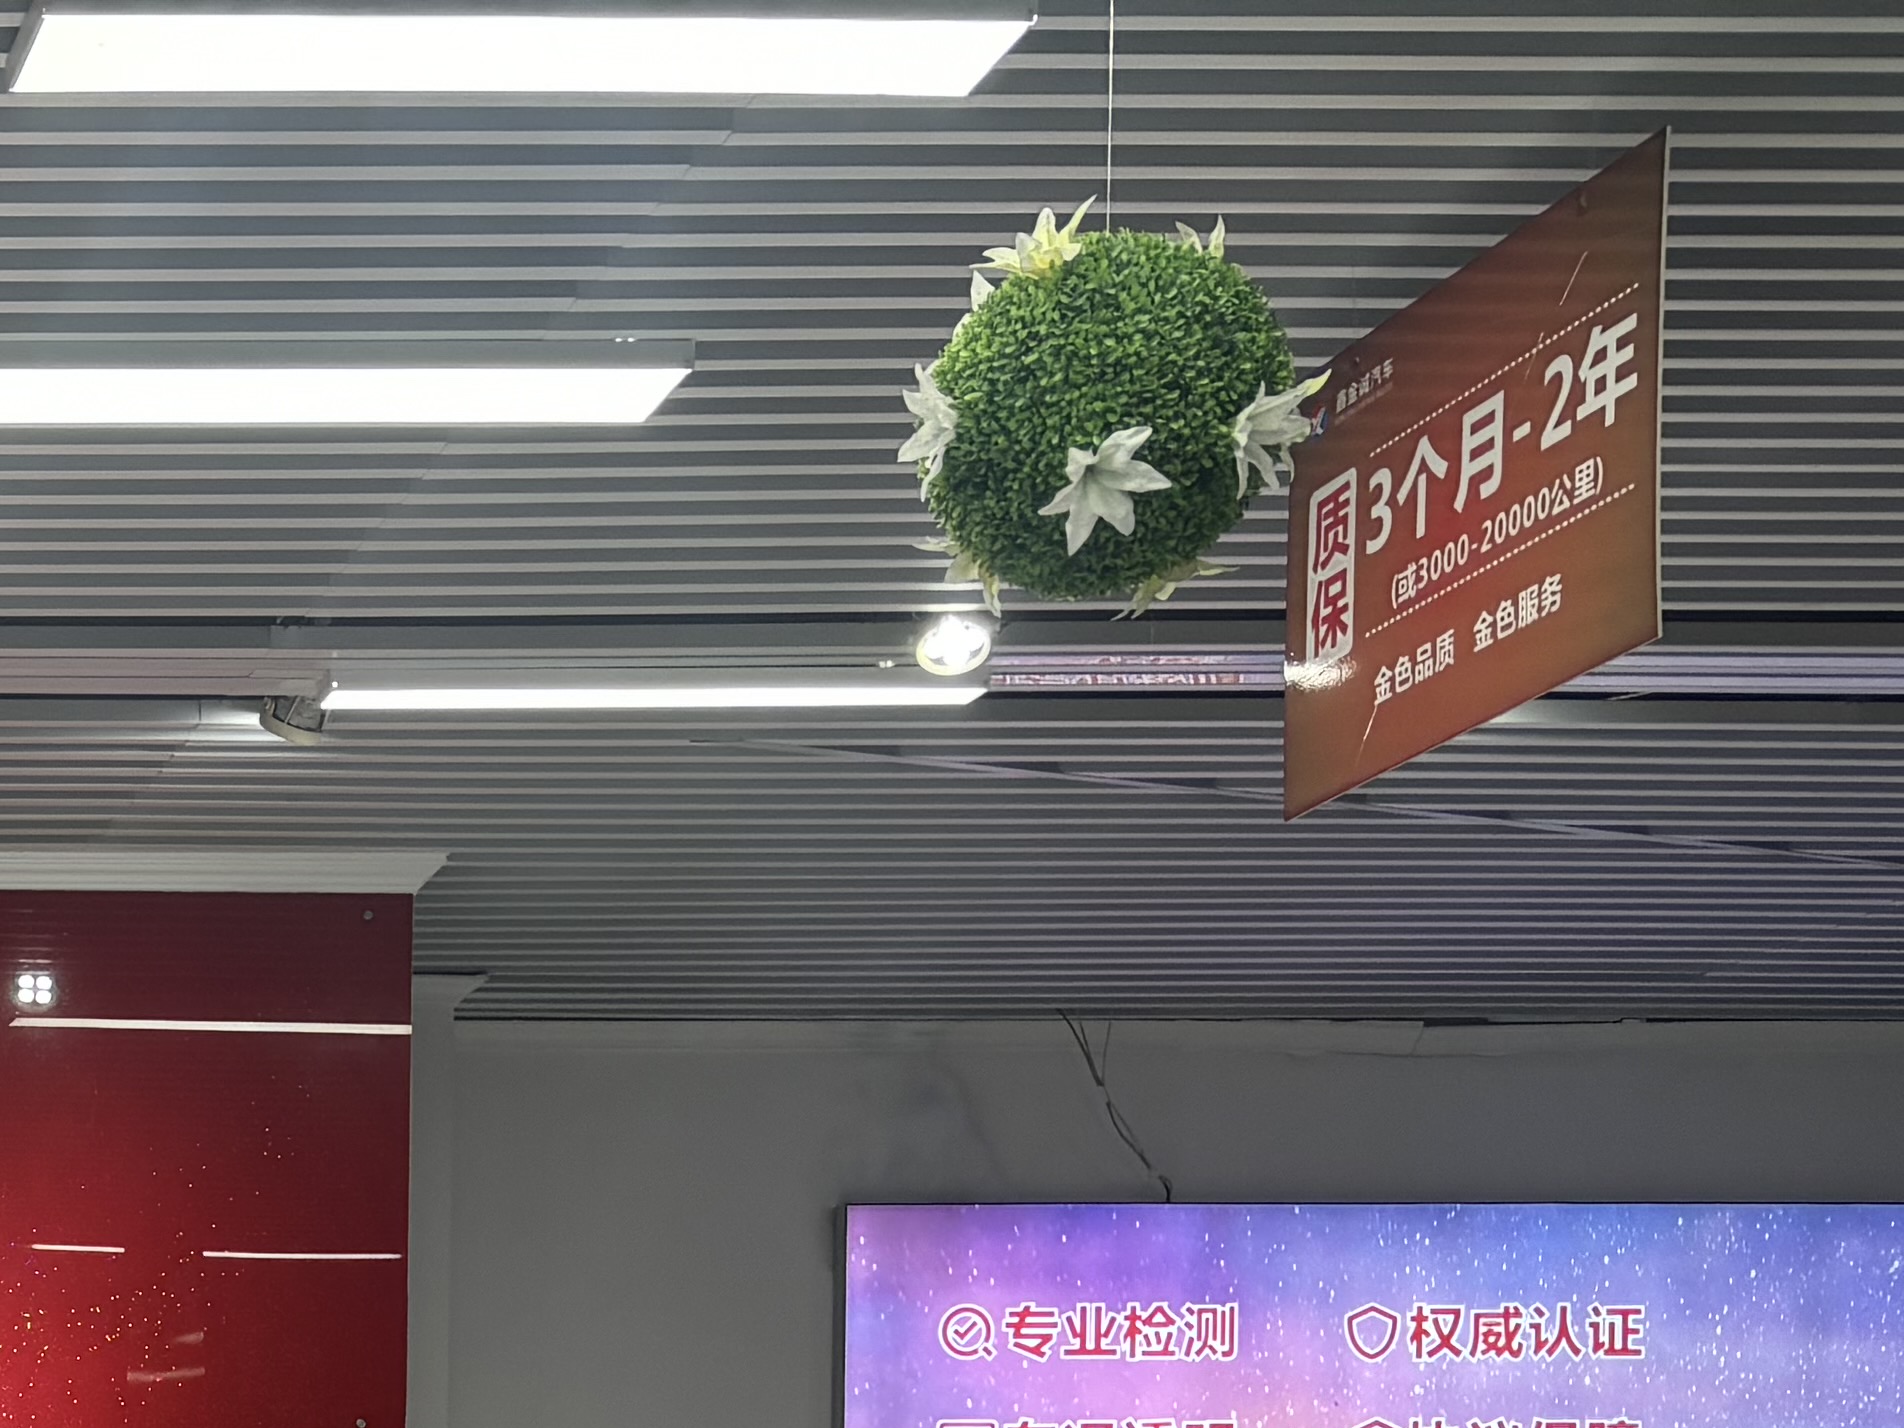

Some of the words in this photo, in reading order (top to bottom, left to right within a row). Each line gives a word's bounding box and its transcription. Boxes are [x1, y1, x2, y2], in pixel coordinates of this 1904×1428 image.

[1364, 312, 1639, 556] 3个月-2年
[1310, 481, 1352, 660] 质保
[1391, 455, 1604, 610] (或3000-20000公里)
[1373, 628, 1456, 706] 金色品质
[1472, 572, 1564, 654] 金色服务
[1002, 1302, 1239, 1362] 专业检测
[1406, 1302, 1647, 1362] 权威认证
